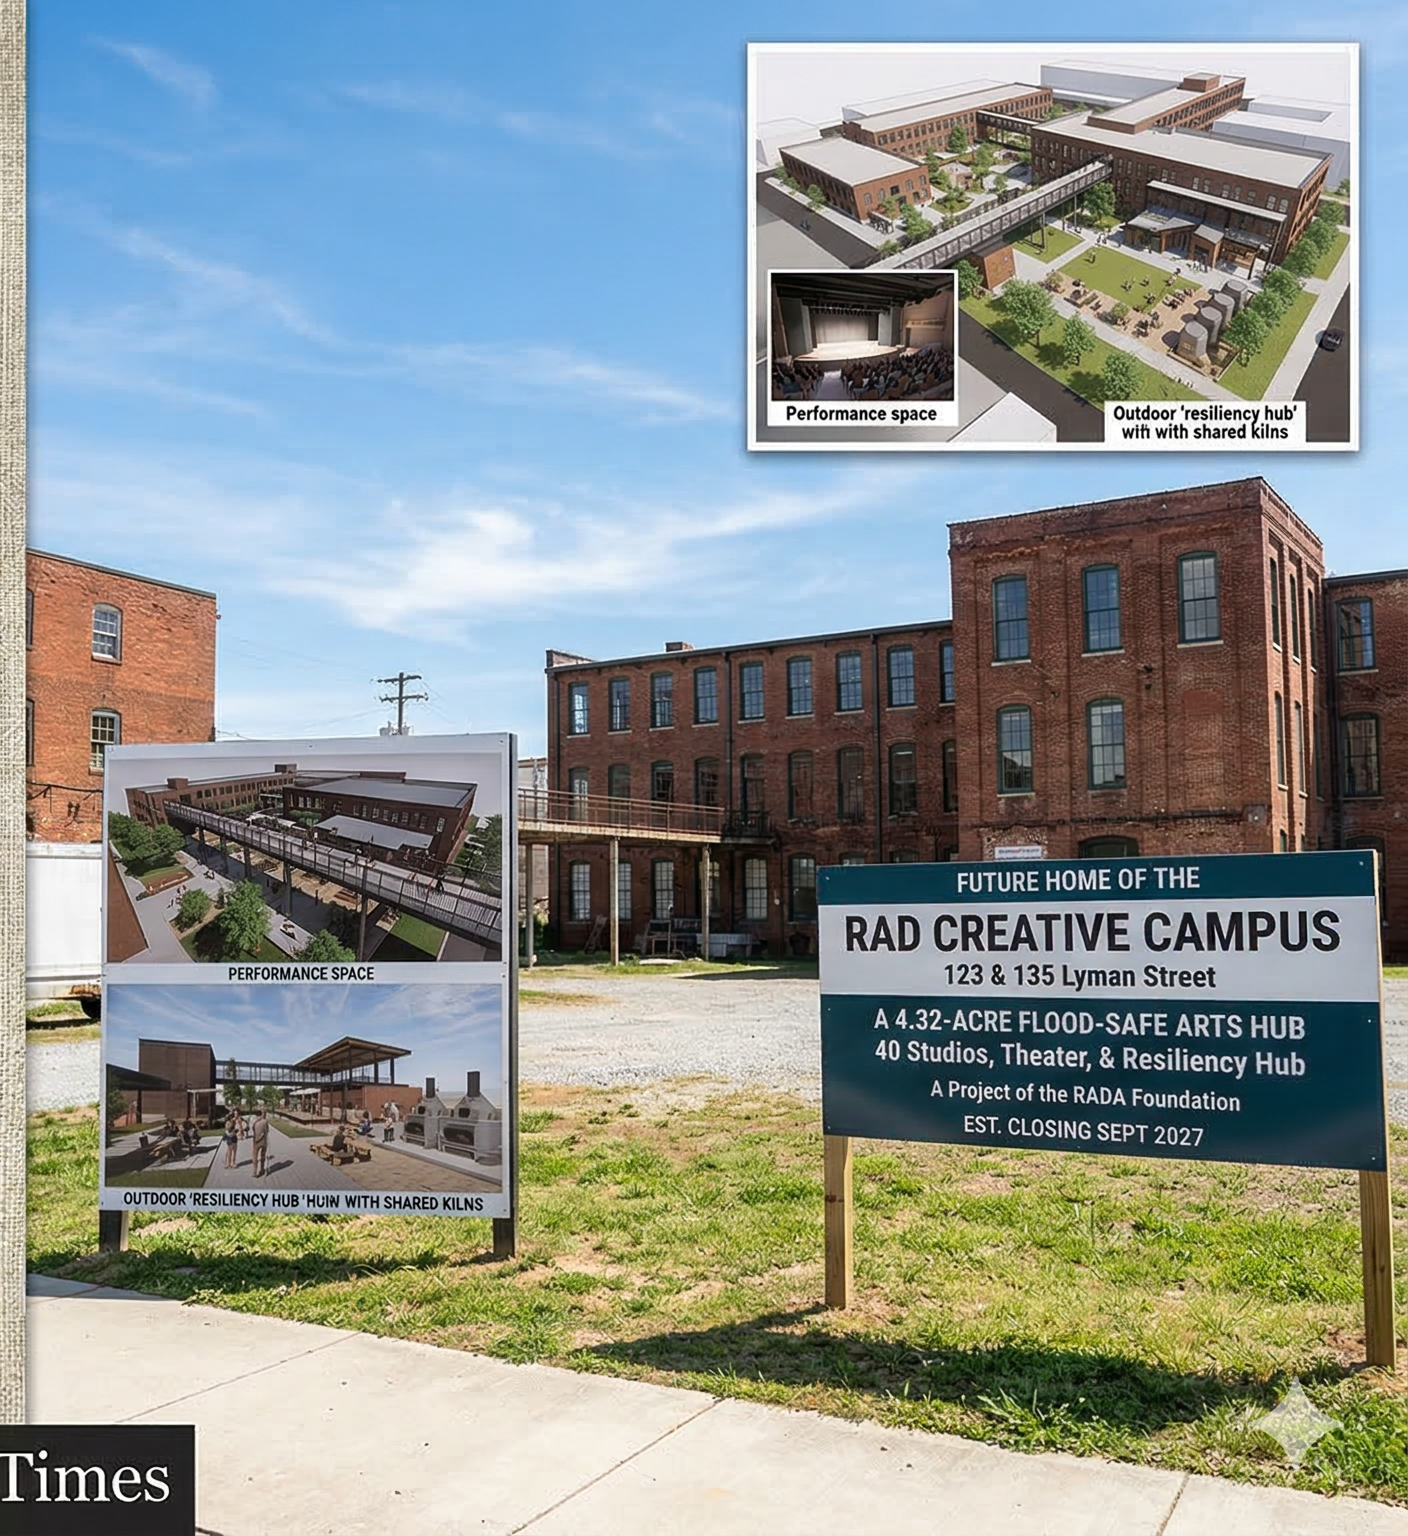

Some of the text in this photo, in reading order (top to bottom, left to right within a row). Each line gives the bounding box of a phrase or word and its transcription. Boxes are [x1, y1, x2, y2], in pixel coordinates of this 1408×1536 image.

[957, 867, 1200, 893] FUTURE HOME OF THE
[845, 910, 1341, 952] RAD CREATIVE CAMPUS
[229, 967, 375, 981] PERFORMANCE SPACE
[945, 964, 1216, 992] 123 & 135 Lyman Street
[874, 1008, 1305, 1040] A 4.32-ACRE FLOOD-SAFE ARTS HUB
[875, 1040, 1306, 1079] 40 Studios, Theater, & Resiliency Hub
[930, 1080, 1241, 1111] A Project of the RADA Foundation
[964, 1115, 1204, 1147] EST. CLOSING SEPT 2027
[123, 1192, 187, 1206] OUTDOOR
[345, 1195, 380, 1209] WITH
[383, 1196, 438, 1210] SHARED
[443, 1197, 484, 1211] KILNS
